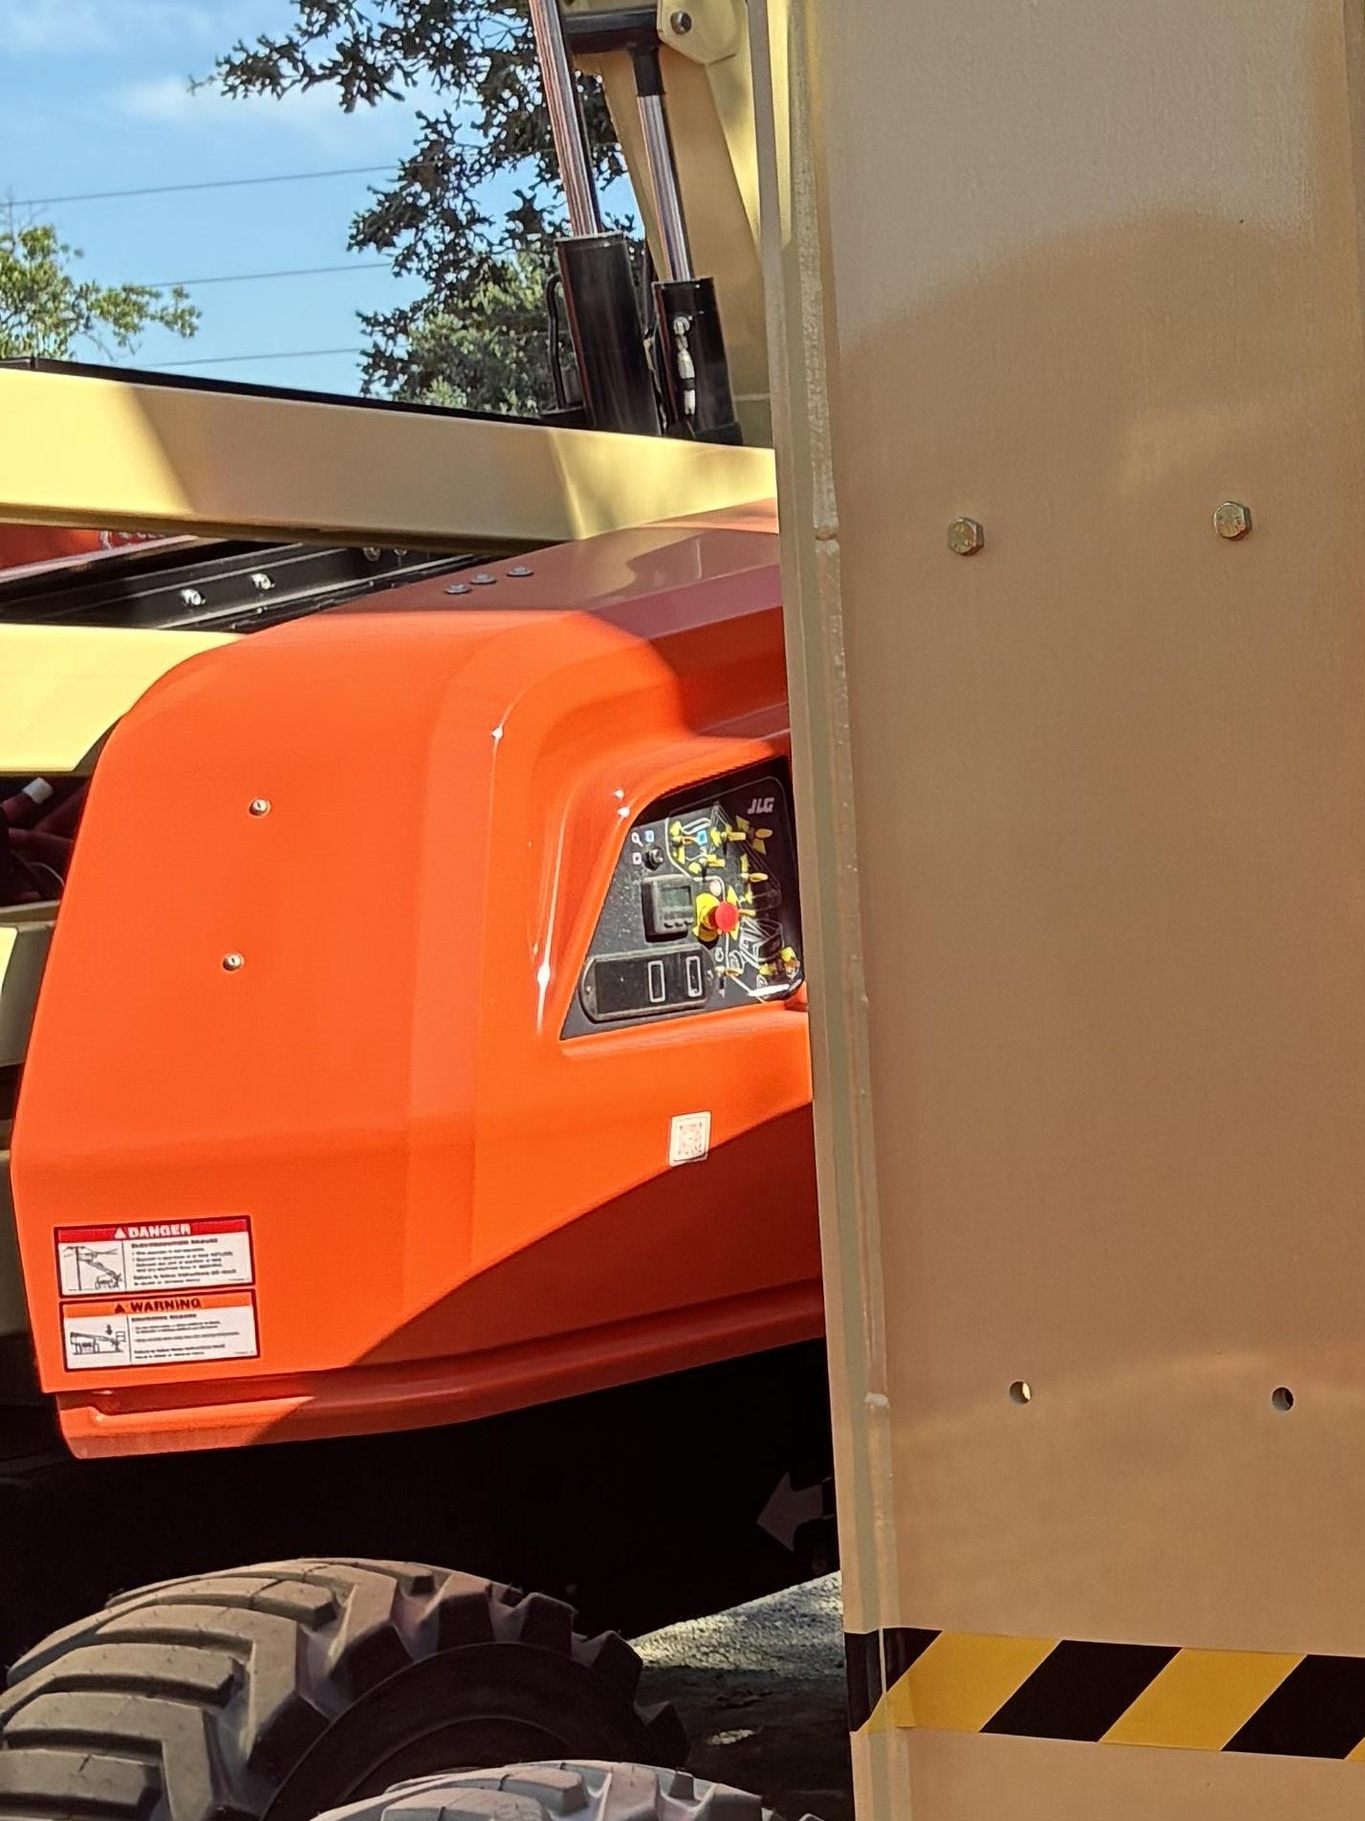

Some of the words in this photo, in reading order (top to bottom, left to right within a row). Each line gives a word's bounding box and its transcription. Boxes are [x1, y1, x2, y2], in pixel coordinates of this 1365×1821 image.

[747, 797, 775, 815] JLG
[129, 1223, 191, 1238] DANGER
[130, 1298, 201, 1313] WARNING
